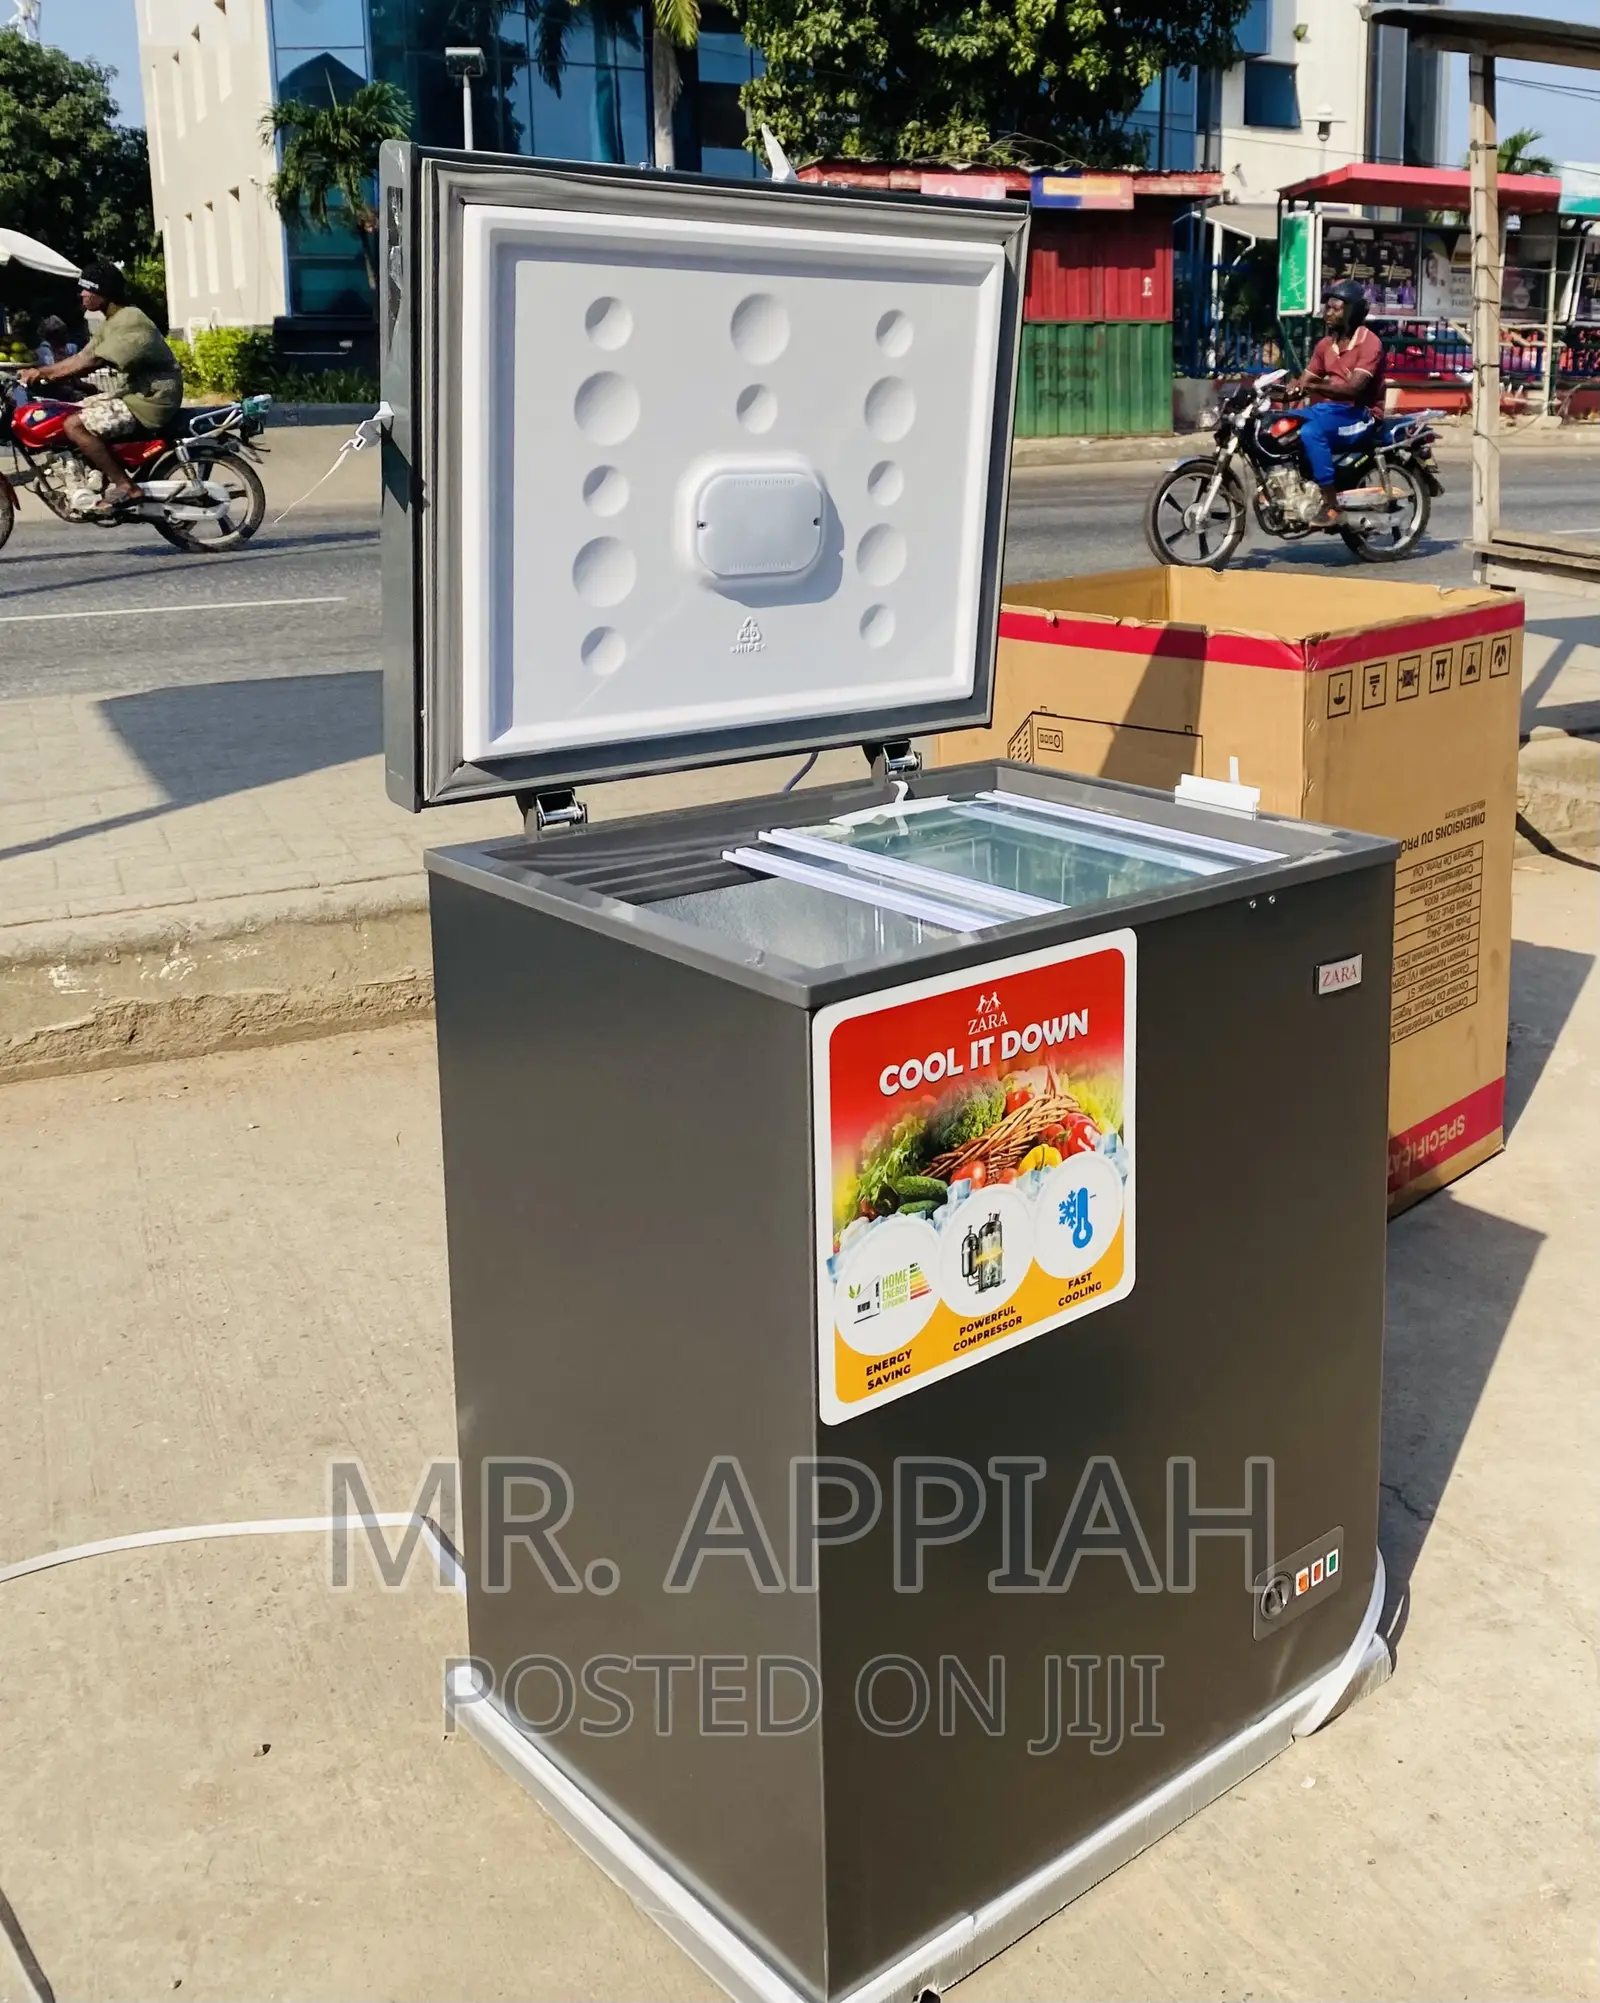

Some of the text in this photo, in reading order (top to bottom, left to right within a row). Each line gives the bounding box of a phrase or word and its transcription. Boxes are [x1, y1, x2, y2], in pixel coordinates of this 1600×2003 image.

[1421, 830, 1434, 845] DU
[1435, 812, 1486, 840] DIMENSIONS
[1322, 964, 1357, 988] ZARA
[968, 1011, 1009, 1036] ZARA
[879, 1008, 1090, 1096] COOL IT DOWN
[882, 1269, 908, 1291] HOME
[882, 1283, 909, 1302] ENERGY
[1067, 1272, 1093, 1290] FAST
[1058, 1281, 1103, 1307] COOLING
[953, 1315, 1023, 1352] COMPRESSOR
[959, 1305, 1017, 1336] POWERFUL
[866, 1349, 912, 1377] ENERGY
[867, 1364, 912, 1391] SAVING
